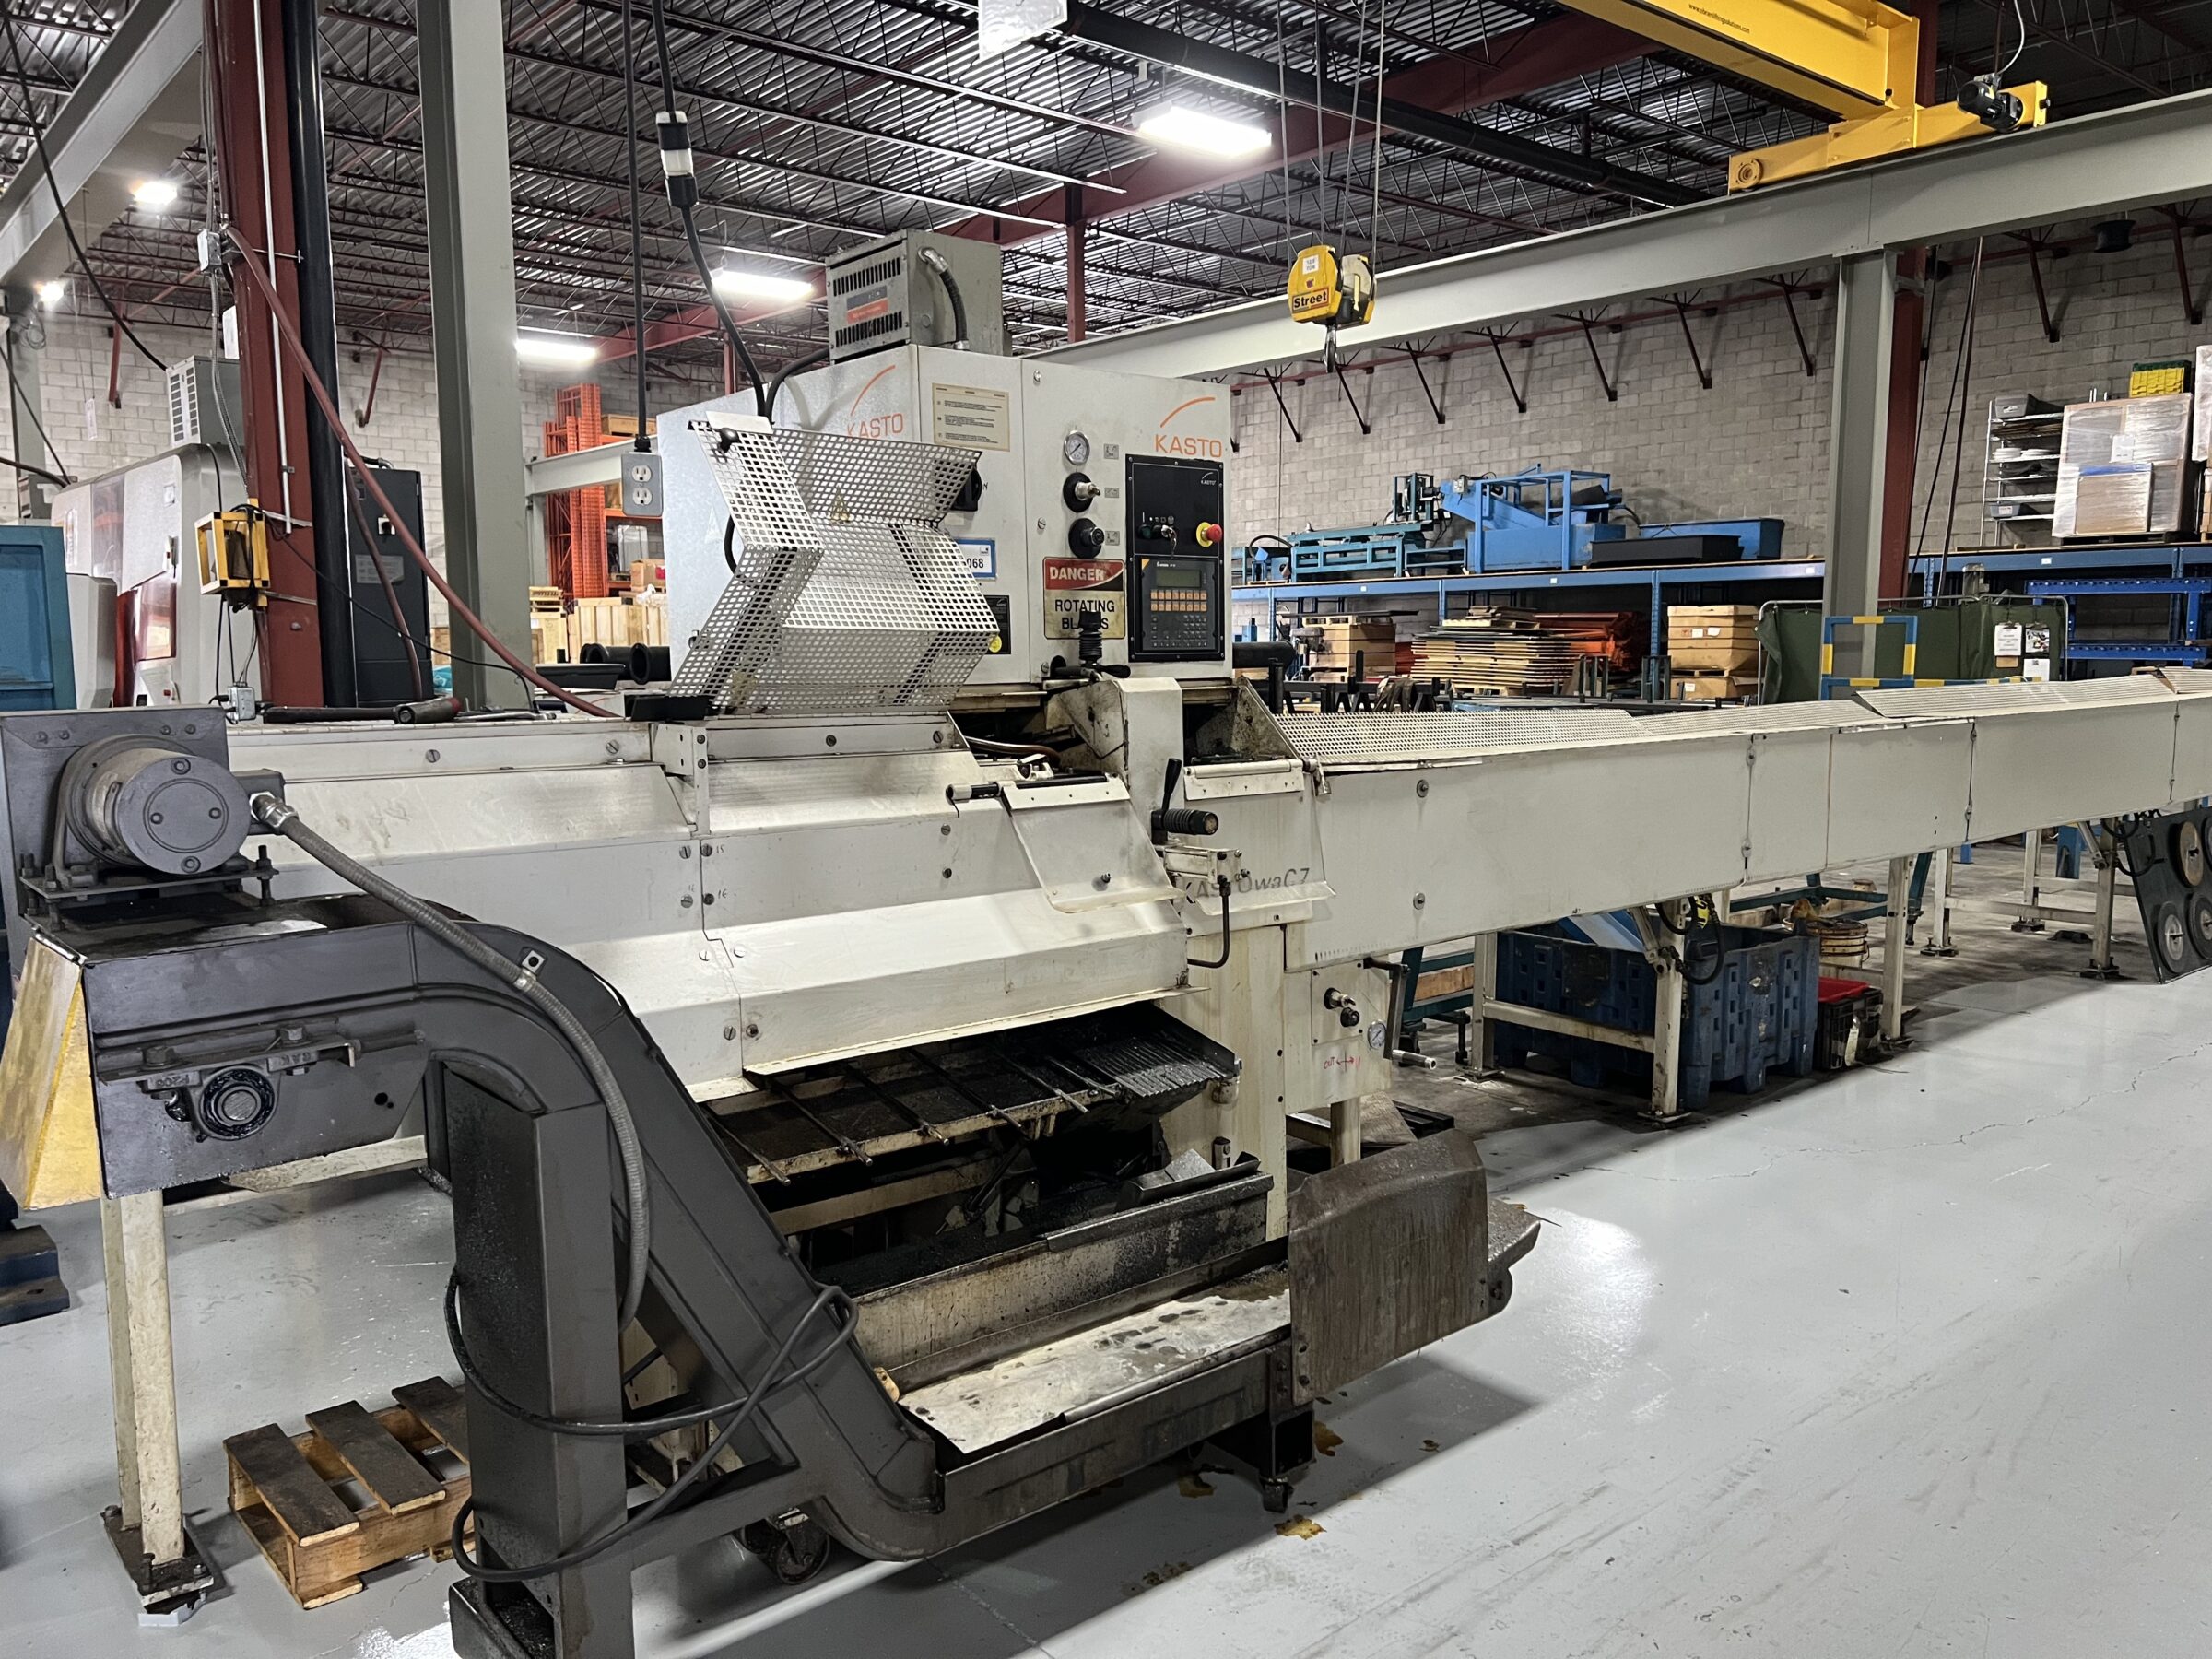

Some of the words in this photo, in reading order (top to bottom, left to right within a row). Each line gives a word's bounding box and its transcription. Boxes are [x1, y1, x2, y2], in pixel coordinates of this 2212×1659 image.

[1293, 291, 1327, 309] Street
[847, 413, 903, 440] KASTO
[1155, 434, 1222, 458] KASTO
[1049, 566, 1104, 581] DANGER
[1054, 599, 1115, 613] ROTATING
[1061, 617, 1109, 629] BLS
